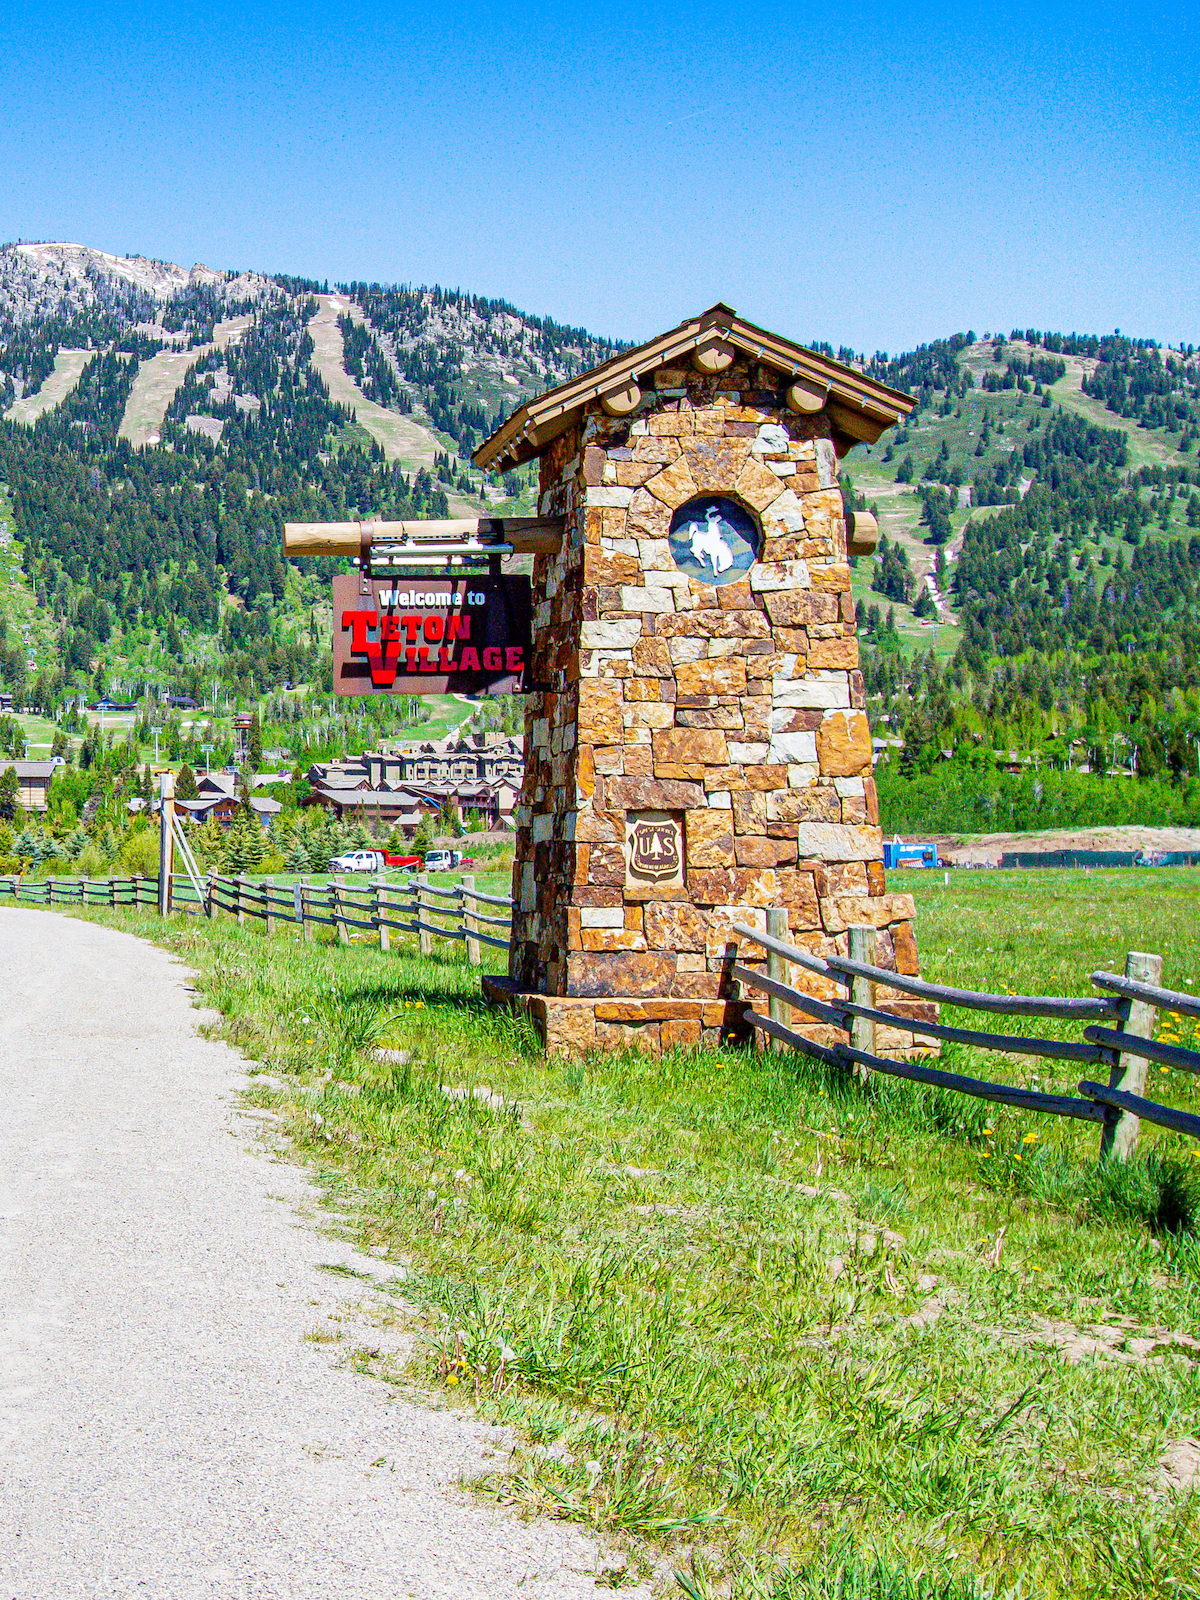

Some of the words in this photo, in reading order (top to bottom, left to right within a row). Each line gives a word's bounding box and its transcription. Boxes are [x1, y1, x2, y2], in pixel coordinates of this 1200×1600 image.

[379, 590, 462, 607] Welcome
[467, 590, 486, 606] to
[342, 611, 471, 653] TETON
[368, 642, 525, 685] VILLAGE
